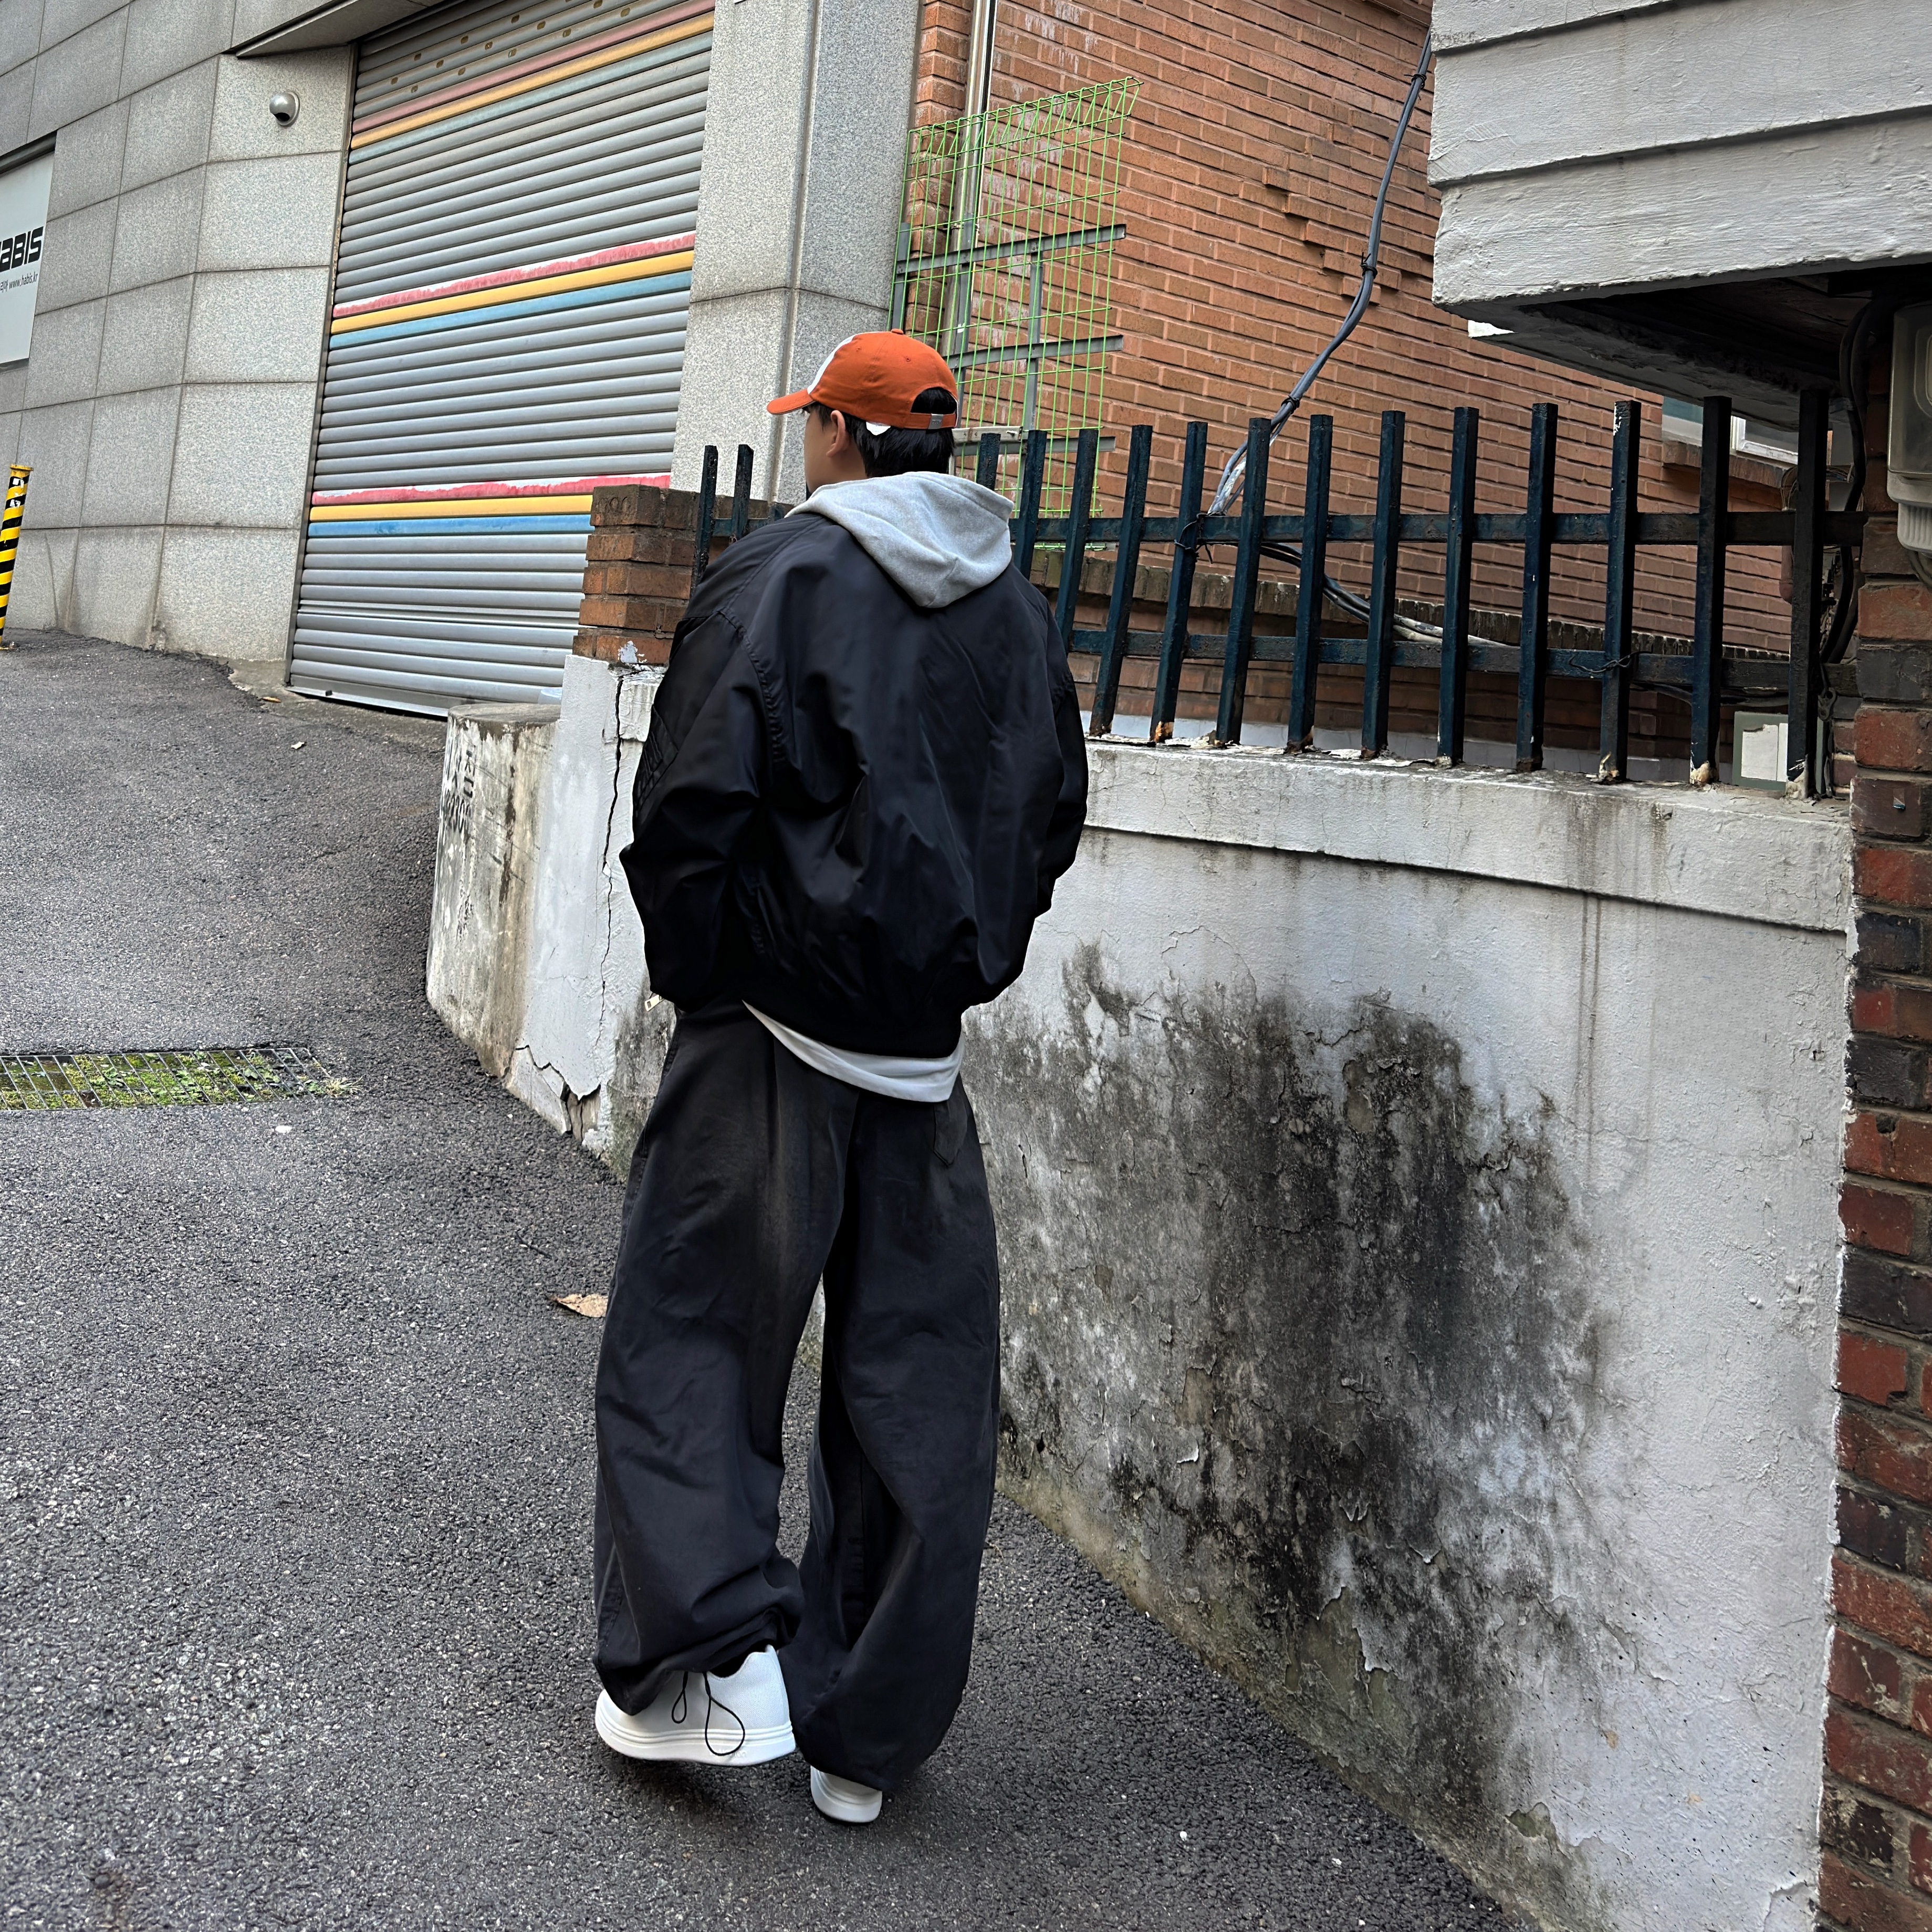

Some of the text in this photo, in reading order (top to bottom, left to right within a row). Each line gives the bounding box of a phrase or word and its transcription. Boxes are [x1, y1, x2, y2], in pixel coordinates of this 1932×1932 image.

[0, 226, 44, 272] aBIS
[0, 271, 38, 293] 리아 www.habis.kr
